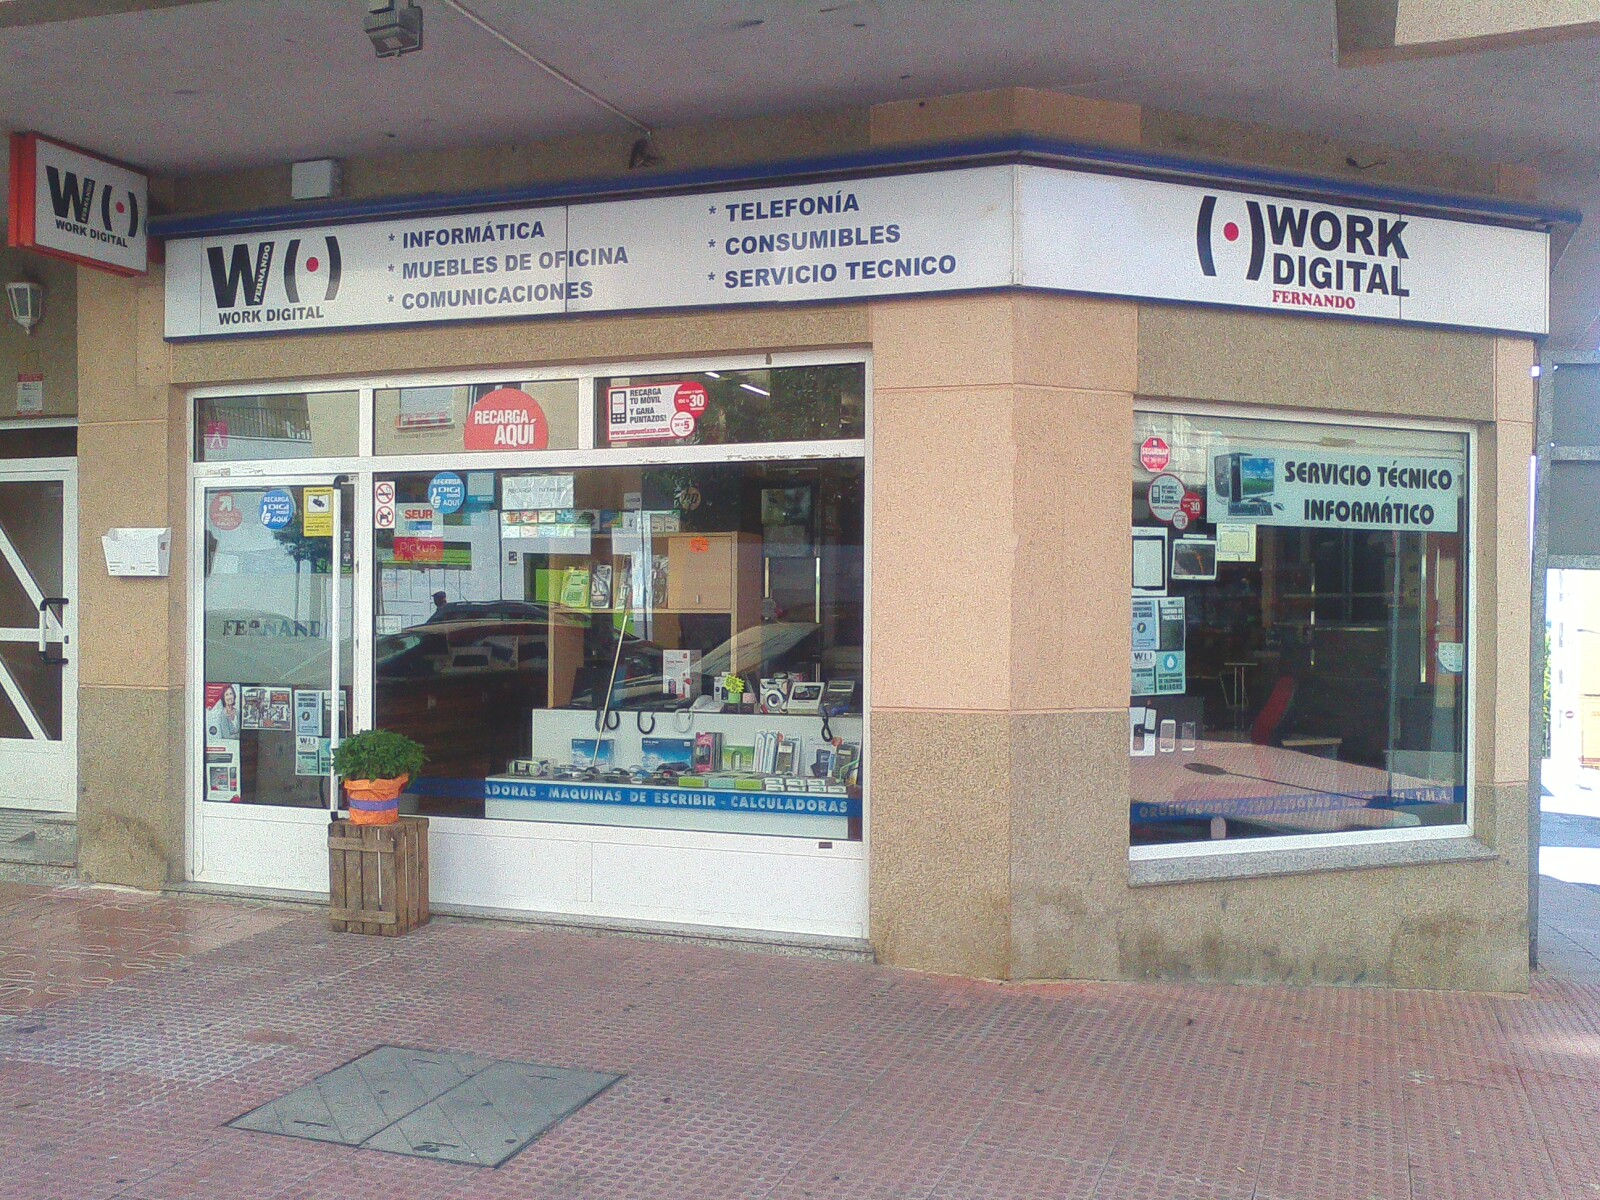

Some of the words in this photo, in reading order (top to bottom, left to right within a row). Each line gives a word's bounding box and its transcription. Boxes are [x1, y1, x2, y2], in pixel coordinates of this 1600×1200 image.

[725, 190, 860, 222] TELEFONÍA
[55, 219, 87, 237] WORK
[90, 228, 128, 248] DIGITAL
[403, 221, 545, 249] INFORMÁTICA
[725, 224, 901, 255] CONSUMIBLES
[1266, 204, 1410, 260] WORK
[402, 256, 498, 279] MUEBLES
[505, 253, 532, 272] DE
[538, 246, 629, 269] OFICINA
[724, 263, 837, 289] SERVICIO
[845, 254, 957, 280] TECNICO
[1272, 253, 1410, 298] DIGITAL
[401, 281, 593, 310] COMUNICACIONES
[1272, 290, 1356, 310] FERNANDO
[218, 310, 262, 325] WORK
[266, 306, 324, 322] DIGITAL
[630, 388, 662, 397] RECARGA
[689, 394, 704, 407] 30
[474, 409, 529, 425] RECARGA
[494, 418, 537, 447] AQUÍ
[1284, 461, 1371, 487] SERVICIO
[1377, 460, 1453, 490] TÉCNICO
[404, 509, 433, 520] SEUR
[1304, 496, 1435, 526] INFORMÁTICO
[549, 787, 622, 802] MAQUINAS
[630, 791, 646, 803] DE
[654, 792, 716, 807] ESCRIBIR
[731, 795, 848, 813] CALCULADORAS
